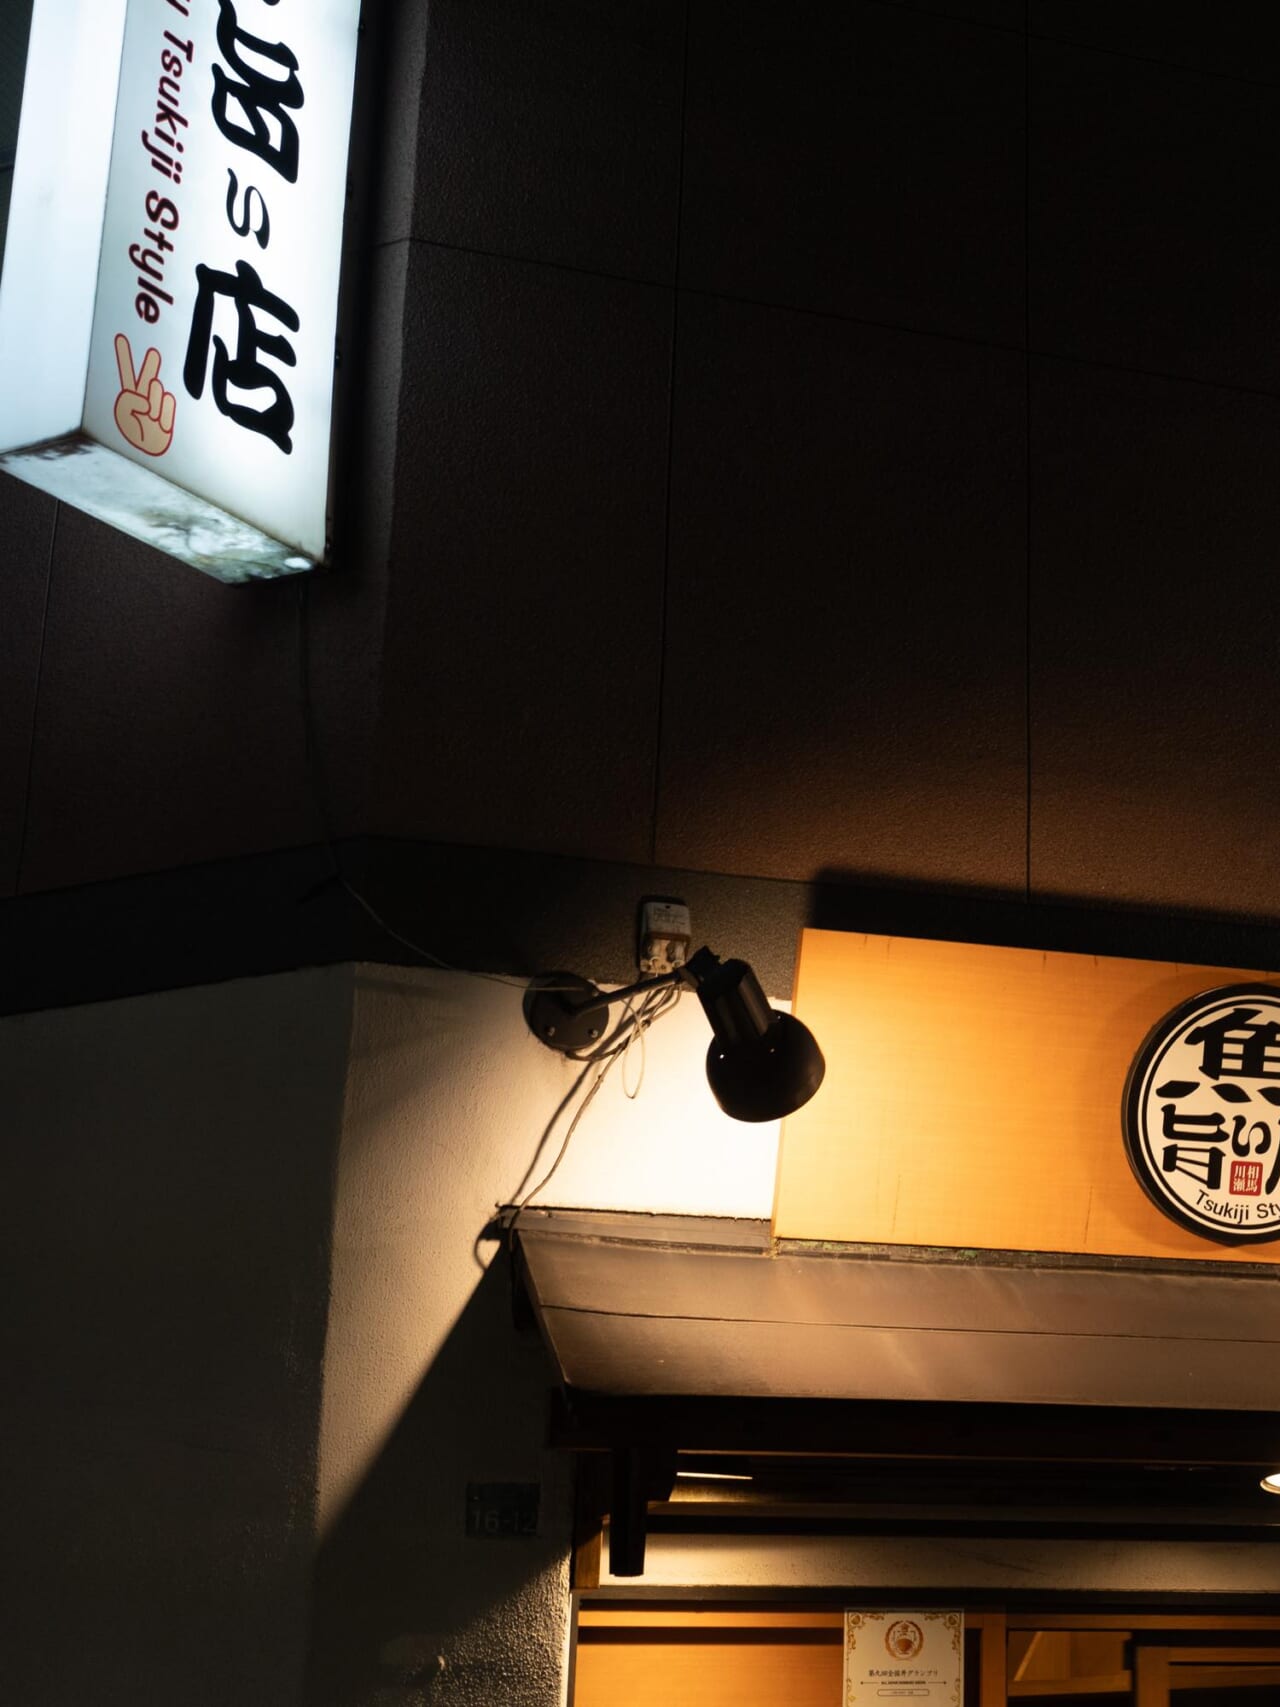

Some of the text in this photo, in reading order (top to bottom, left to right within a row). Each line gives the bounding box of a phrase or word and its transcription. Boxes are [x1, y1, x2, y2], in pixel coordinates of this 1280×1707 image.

[142, 30, 194, 184] Tsukiji
[128, 190, 179, 324] Style
[183, 0, 304, 454] 旨い店
[1196, 1189, 1249, 1224] Tsukiji
